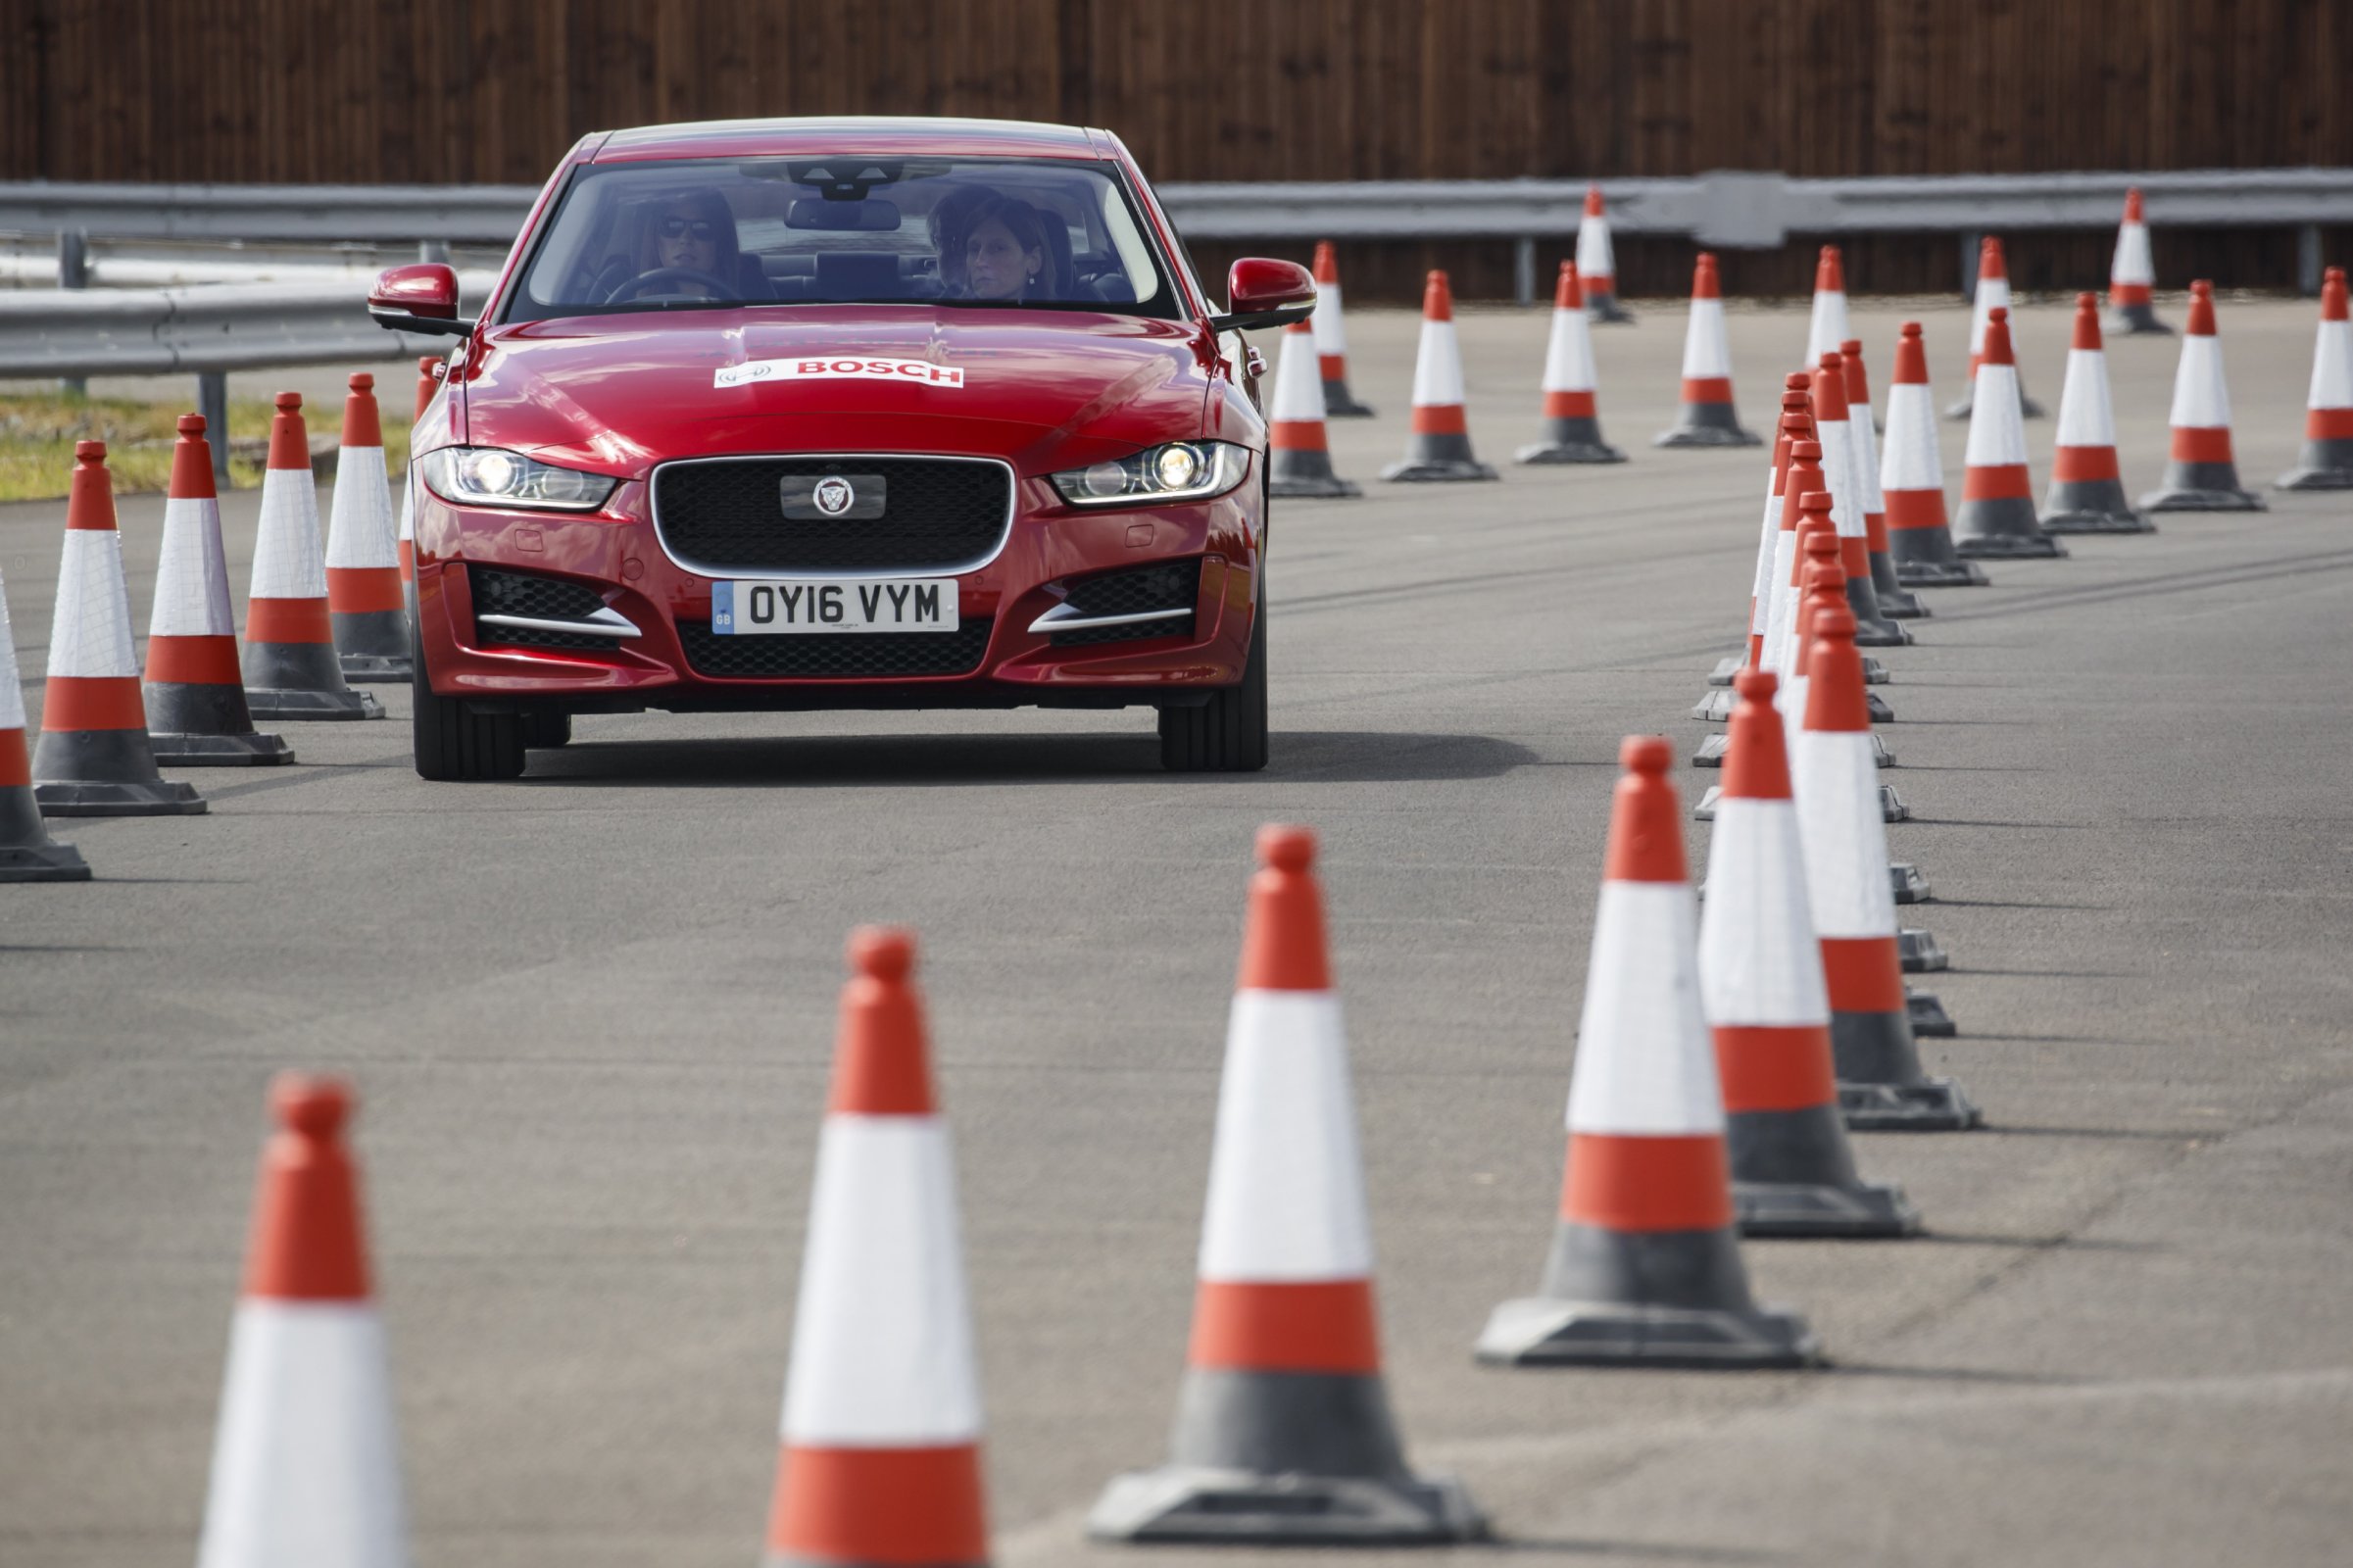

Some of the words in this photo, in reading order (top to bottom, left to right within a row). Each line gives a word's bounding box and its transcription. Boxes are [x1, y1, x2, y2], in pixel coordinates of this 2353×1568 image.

[798, 361, 960, 383] BOSCH
[750, 585, 844, 624] OY16
[858, 584, 940, 623] VYM
[715, 613, 731, 625] GB
